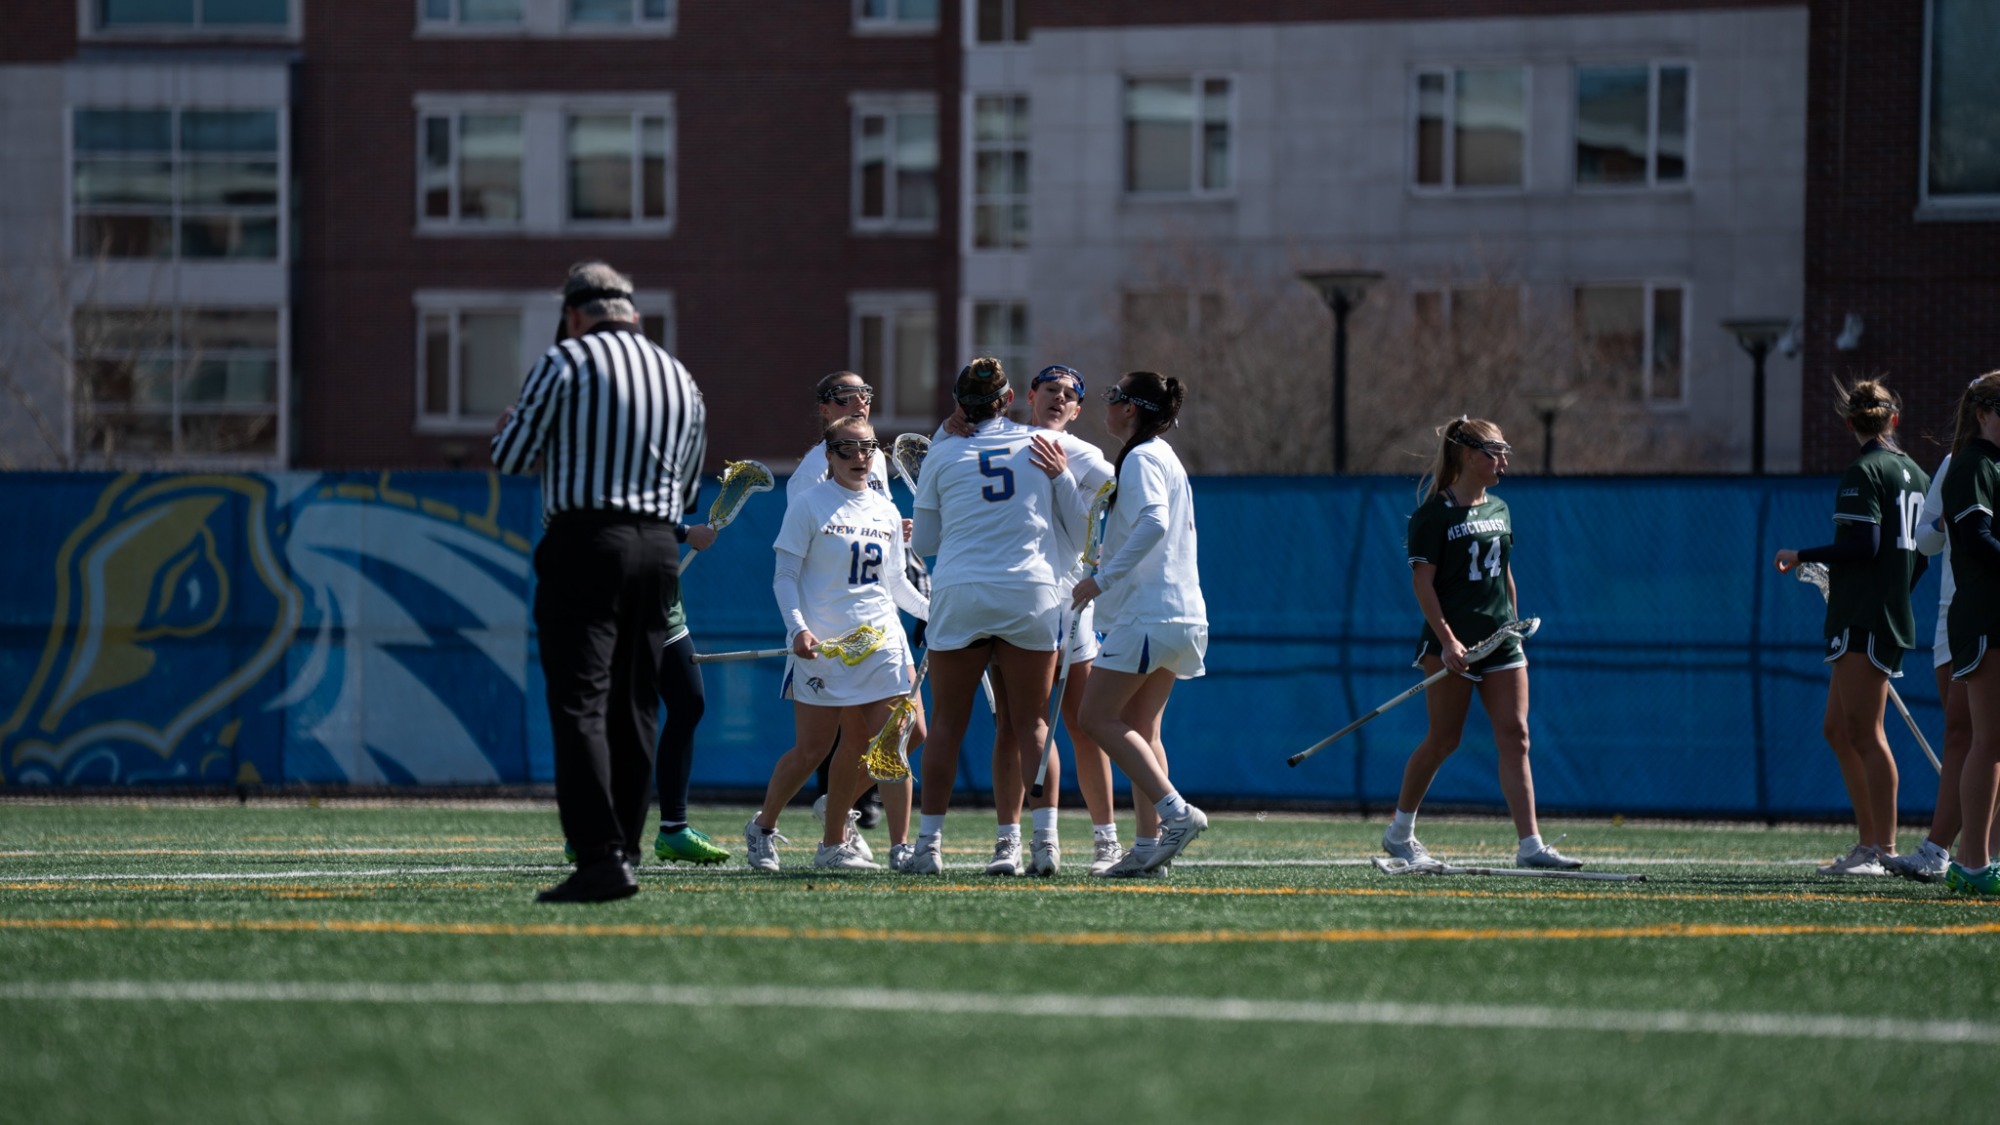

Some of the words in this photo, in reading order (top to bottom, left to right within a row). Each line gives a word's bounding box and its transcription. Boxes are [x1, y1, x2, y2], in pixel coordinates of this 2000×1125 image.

[978, 447, 1016, 503] 5
[824, 524, 857, 535] NEW
[1447, 519, 1506, 540] MERCYHURST
[1896, 489, 1925, 551] 10
[848, 540, 883, 585] 12
[1468, 536, 1502, 581] 14
